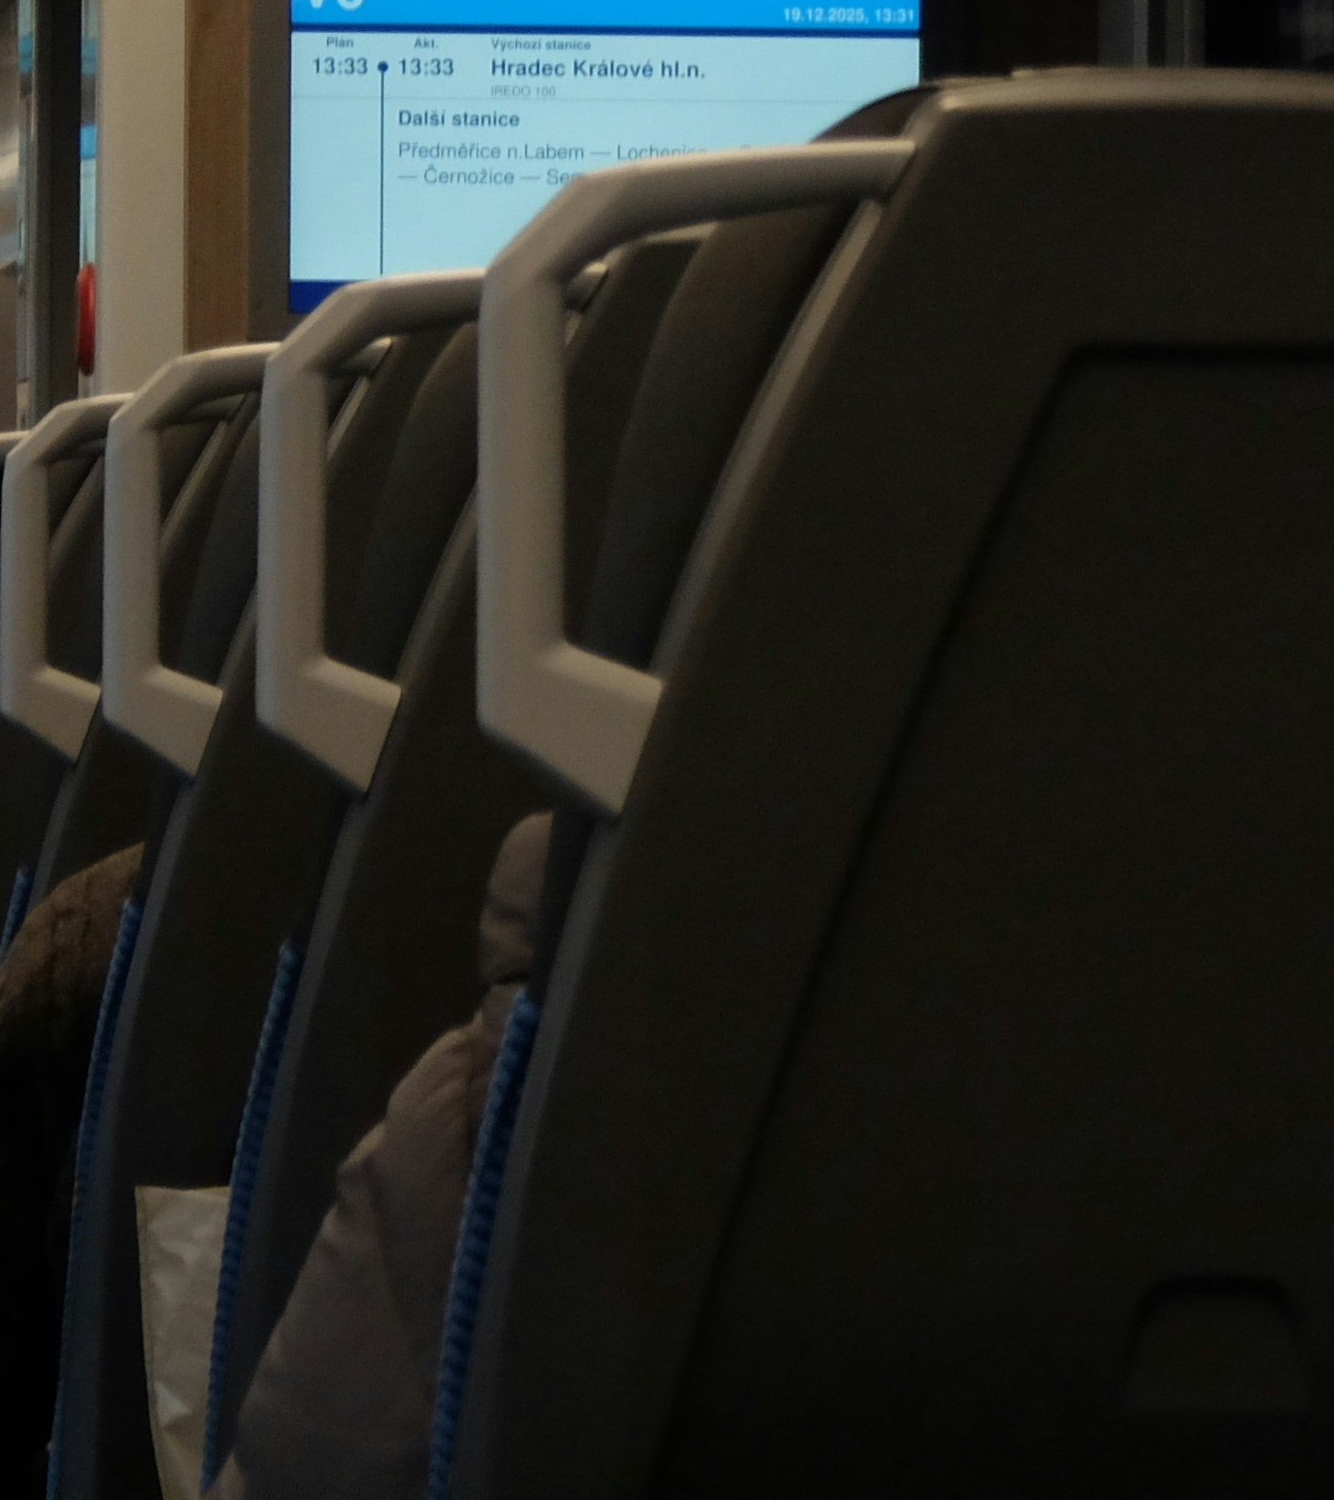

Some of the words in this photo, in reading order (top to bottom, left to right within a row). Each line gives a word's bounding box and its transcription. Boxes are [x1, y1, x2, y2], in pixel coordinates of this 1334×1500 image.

[783, 7, 870, 24] 19.12.2025,
[875, 8, 915, 24] 13:31
[545, 39, 592, 51] stanice
[312, 57, 369, 75] 13:33
[398, 57, 455, 76] 13:33
[490, 57, 567, 77] Hradec
[573, 57, 654, 78] Králové
[661, 59, 706, 79] hl.n.
[398, 109, 445, 127] Další
[452, 111, 520, 128] stanice
[398, 141, 501, 160] Předměřice
[507, 143, 585, 161] n.Labem
[424, 163, 515, 185] Černožice
